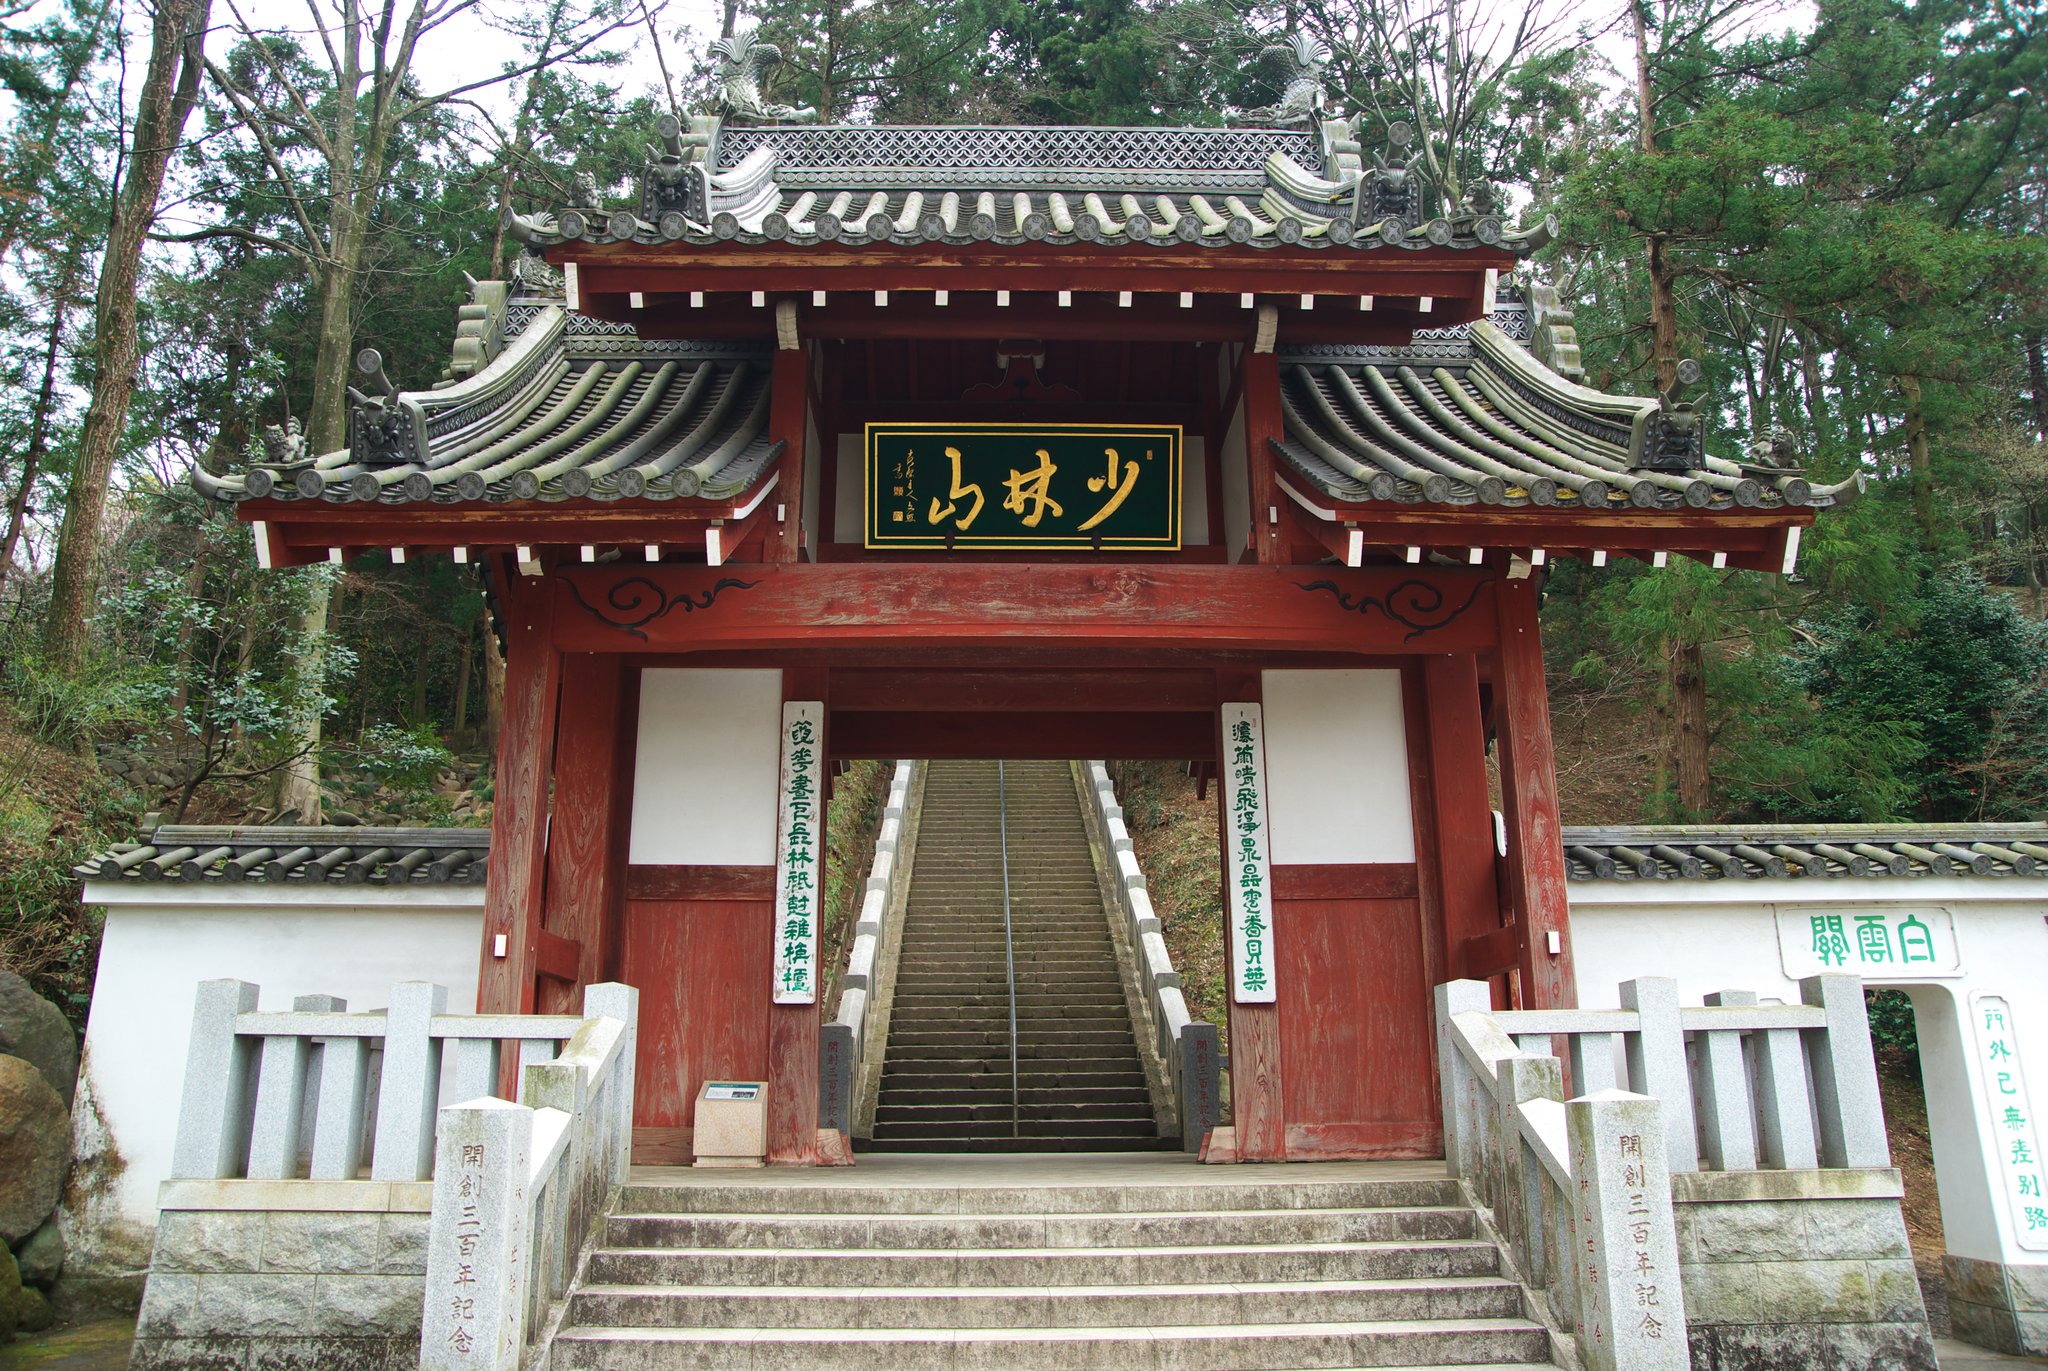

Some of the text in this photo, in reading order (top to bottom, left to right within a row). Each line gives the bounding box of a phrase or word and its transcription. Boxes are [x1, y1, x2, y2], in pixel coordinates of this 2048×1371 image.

[928, 446, 1140, 532] 少林山
[447, 1144, 485, 1354] 開創三百年記念
[1619, 1135, 1664, 1340] 開創三百年記念
